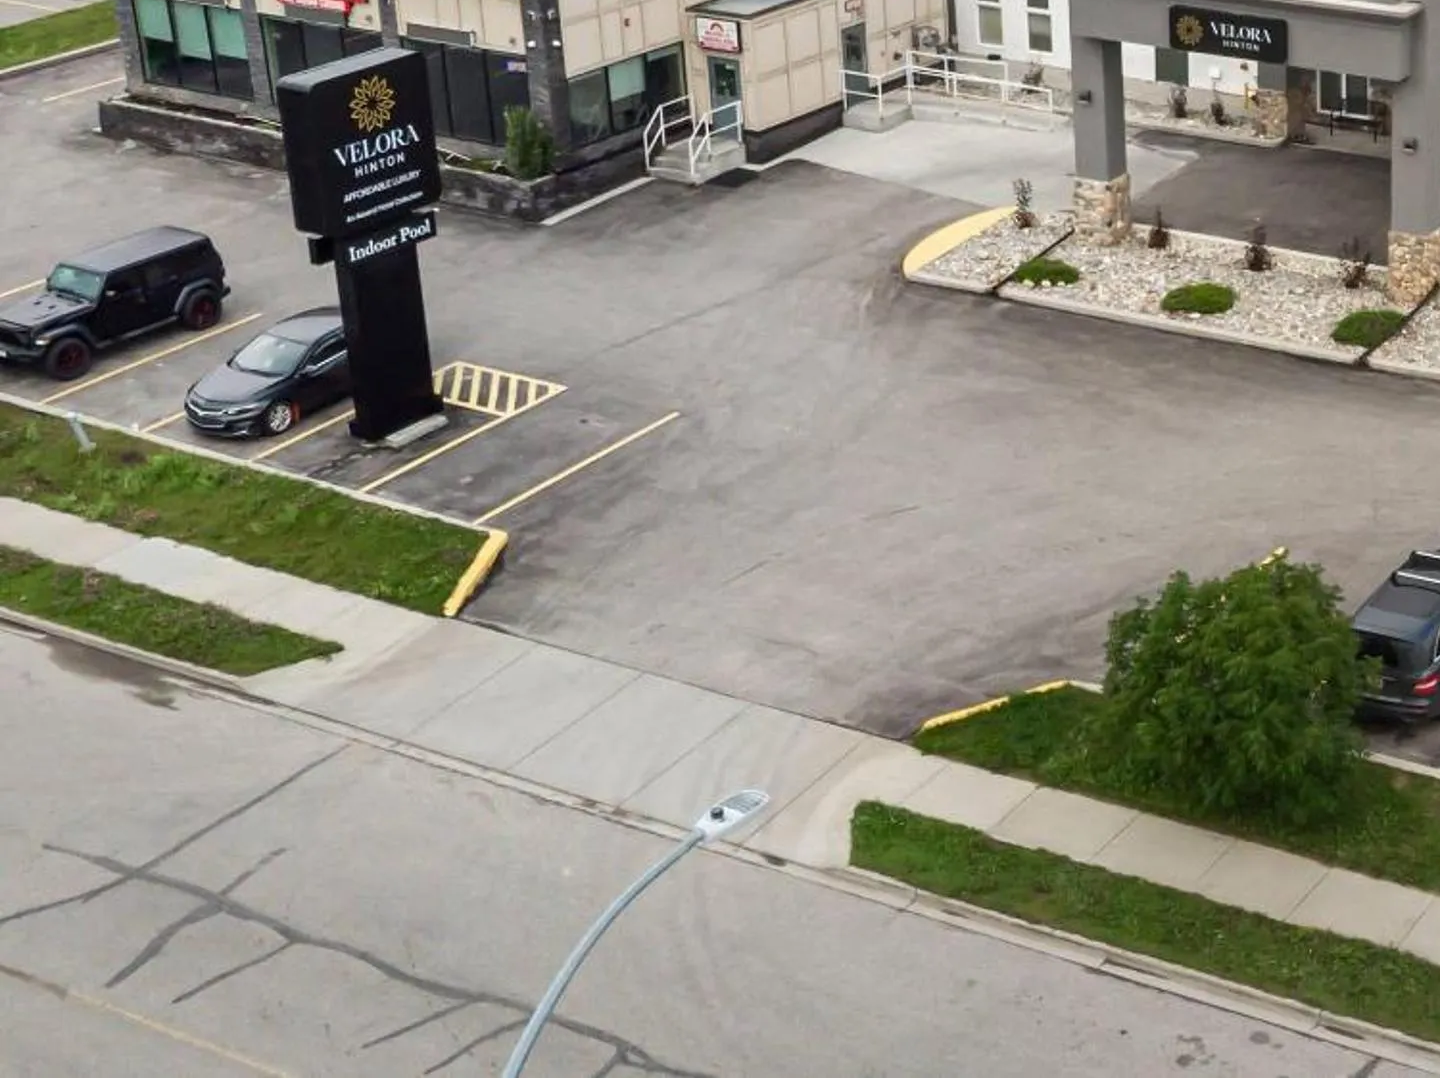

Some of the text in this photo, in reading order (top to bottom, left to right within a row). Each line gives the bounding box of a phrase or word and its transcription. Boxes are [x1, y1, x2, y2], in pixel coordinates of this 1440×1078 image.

[1210, 21, 1272, 44] VELORA
[1222, 39, 1260, 51] HINTON
[333, 124, 421, 167] VELORA
[354, 151, 405, 178] HINTON
[348, 218, 431, 262] Indoor Pool
